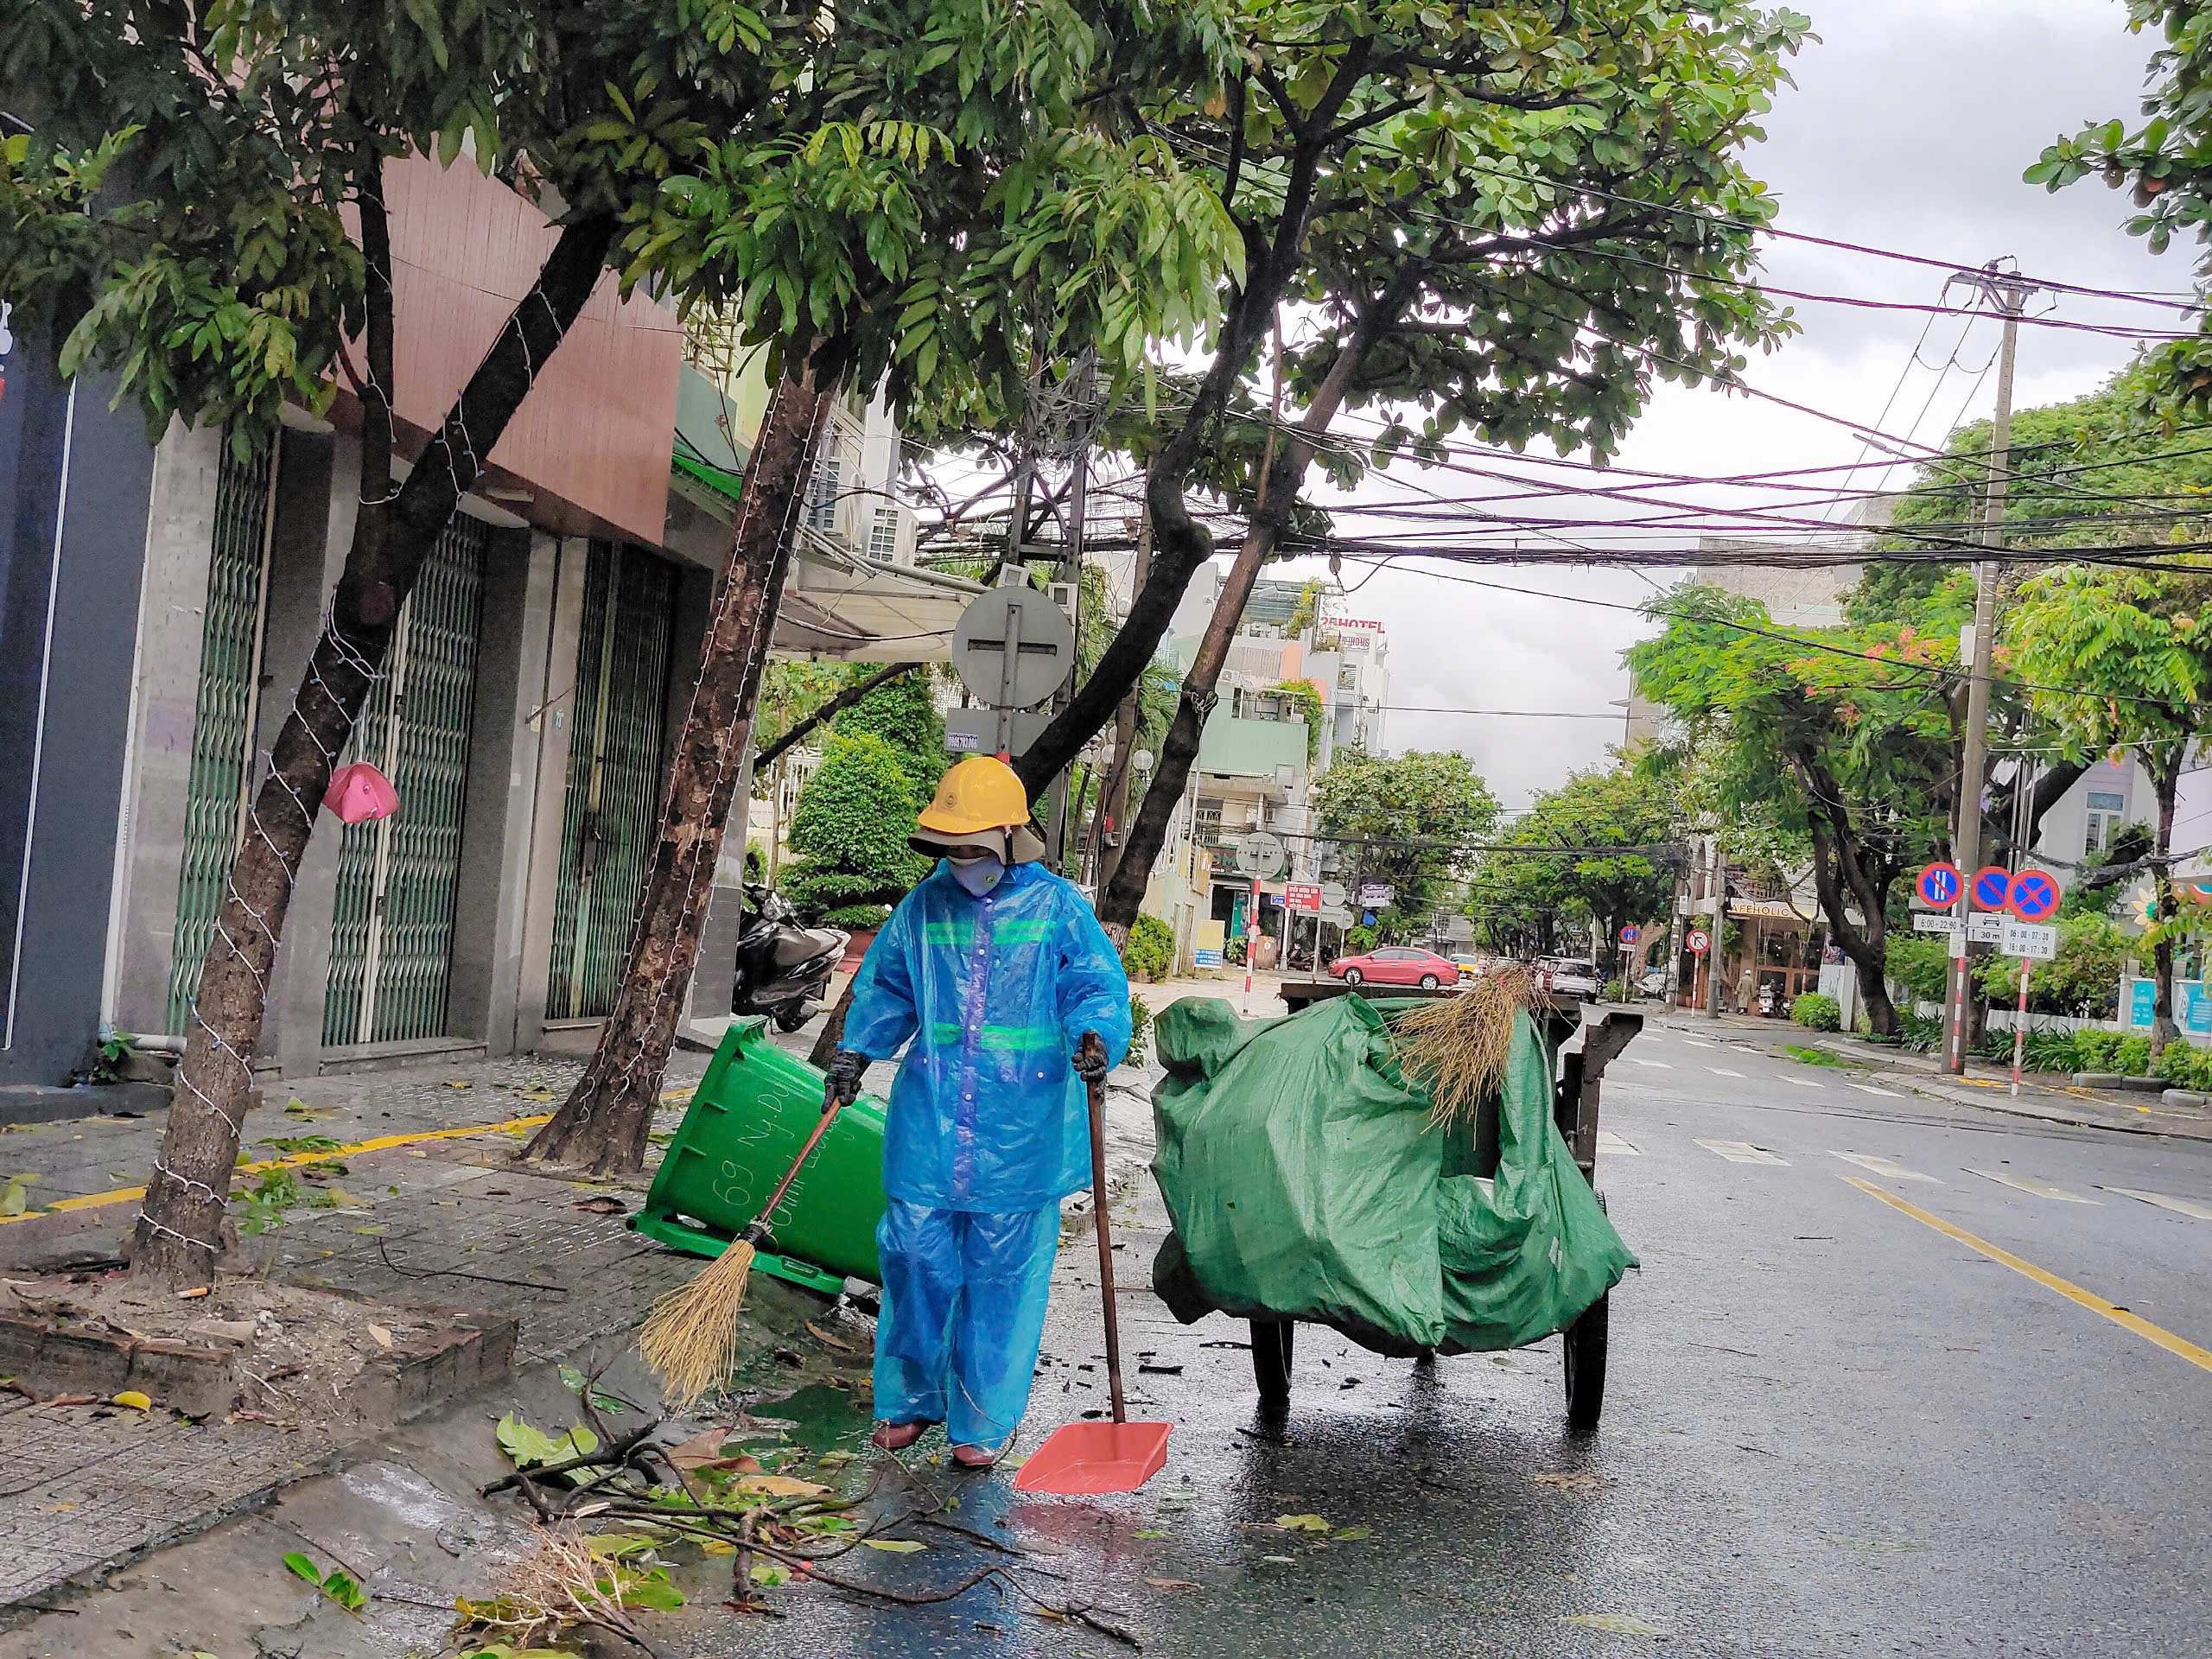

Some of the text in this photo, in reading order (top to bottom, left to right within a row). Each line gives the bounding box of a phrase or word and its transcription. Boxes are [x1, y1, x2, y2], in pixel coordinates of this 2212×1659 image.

[1731, 904, 1789, 917] AFEHOLIC
[1980, 931, 1991, 939] 30
[713, 1160, 753, 1206] 69
